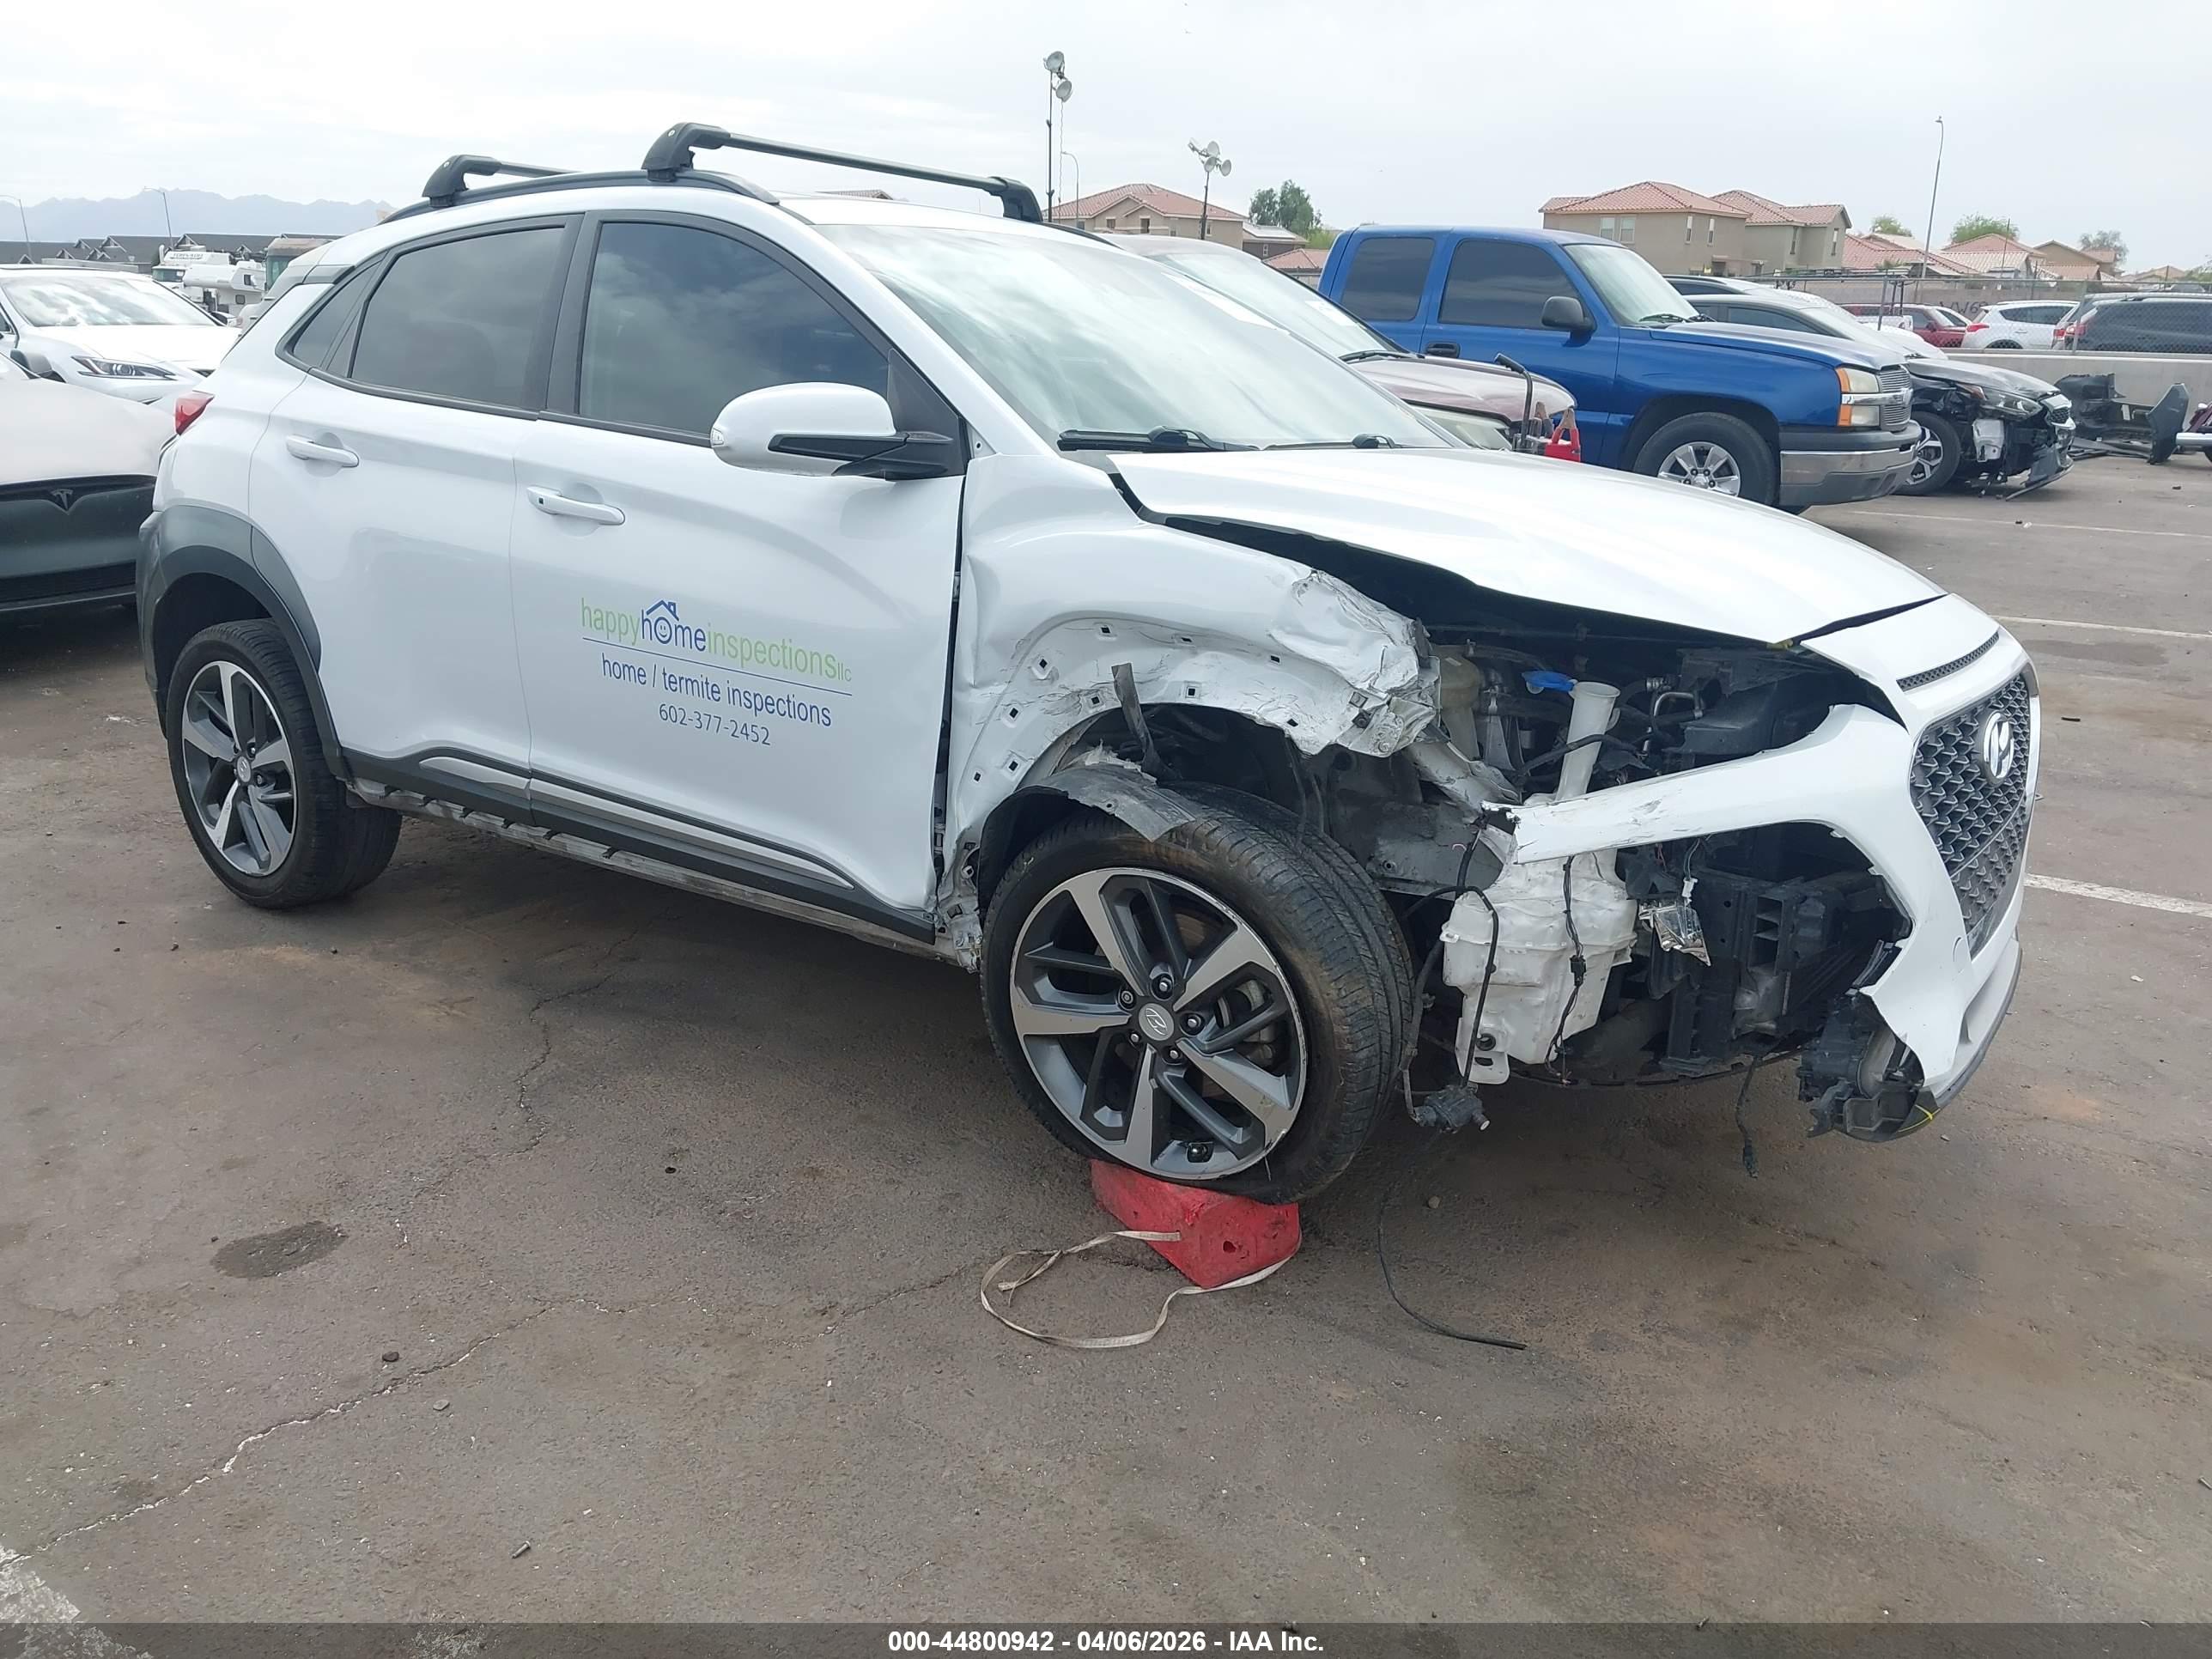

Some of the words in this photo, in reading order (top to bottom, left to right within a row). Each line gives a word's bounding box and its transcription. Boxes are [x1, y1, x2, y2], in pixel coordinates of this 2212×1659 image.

[601, 652, 647, 685] home
[652, 664, 658, 688] /
[661, 666, 721, 702] termite
[726, 679, 832, 727] inspections
[659, 703, 771, 745] 602-377-2452
